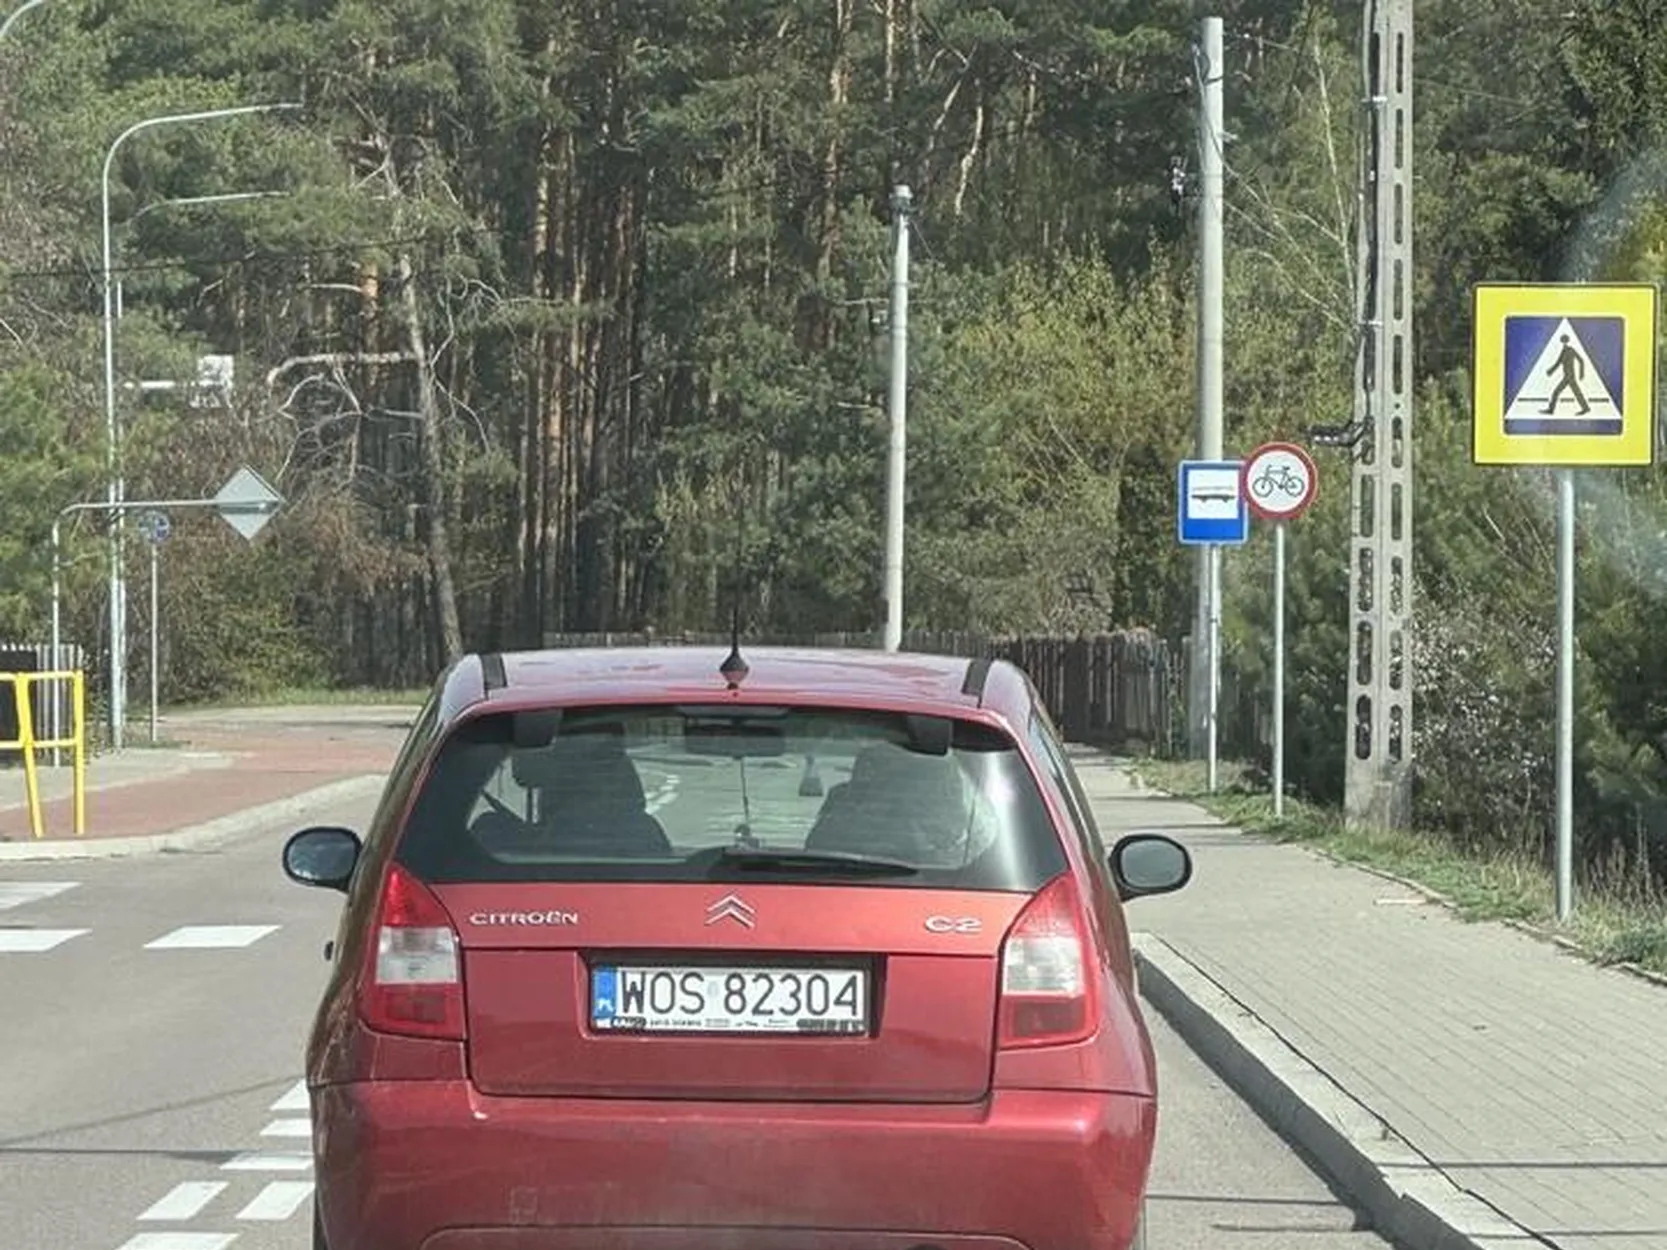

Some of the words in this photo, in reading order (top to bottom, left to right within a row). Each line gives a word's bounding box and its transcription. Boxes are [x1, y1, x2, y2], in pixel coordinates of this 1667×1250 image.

[925, 915, 983, 933] C2
[621, 971, 705, 1015] WOS
[723, 972, 858, 1017] 82304
